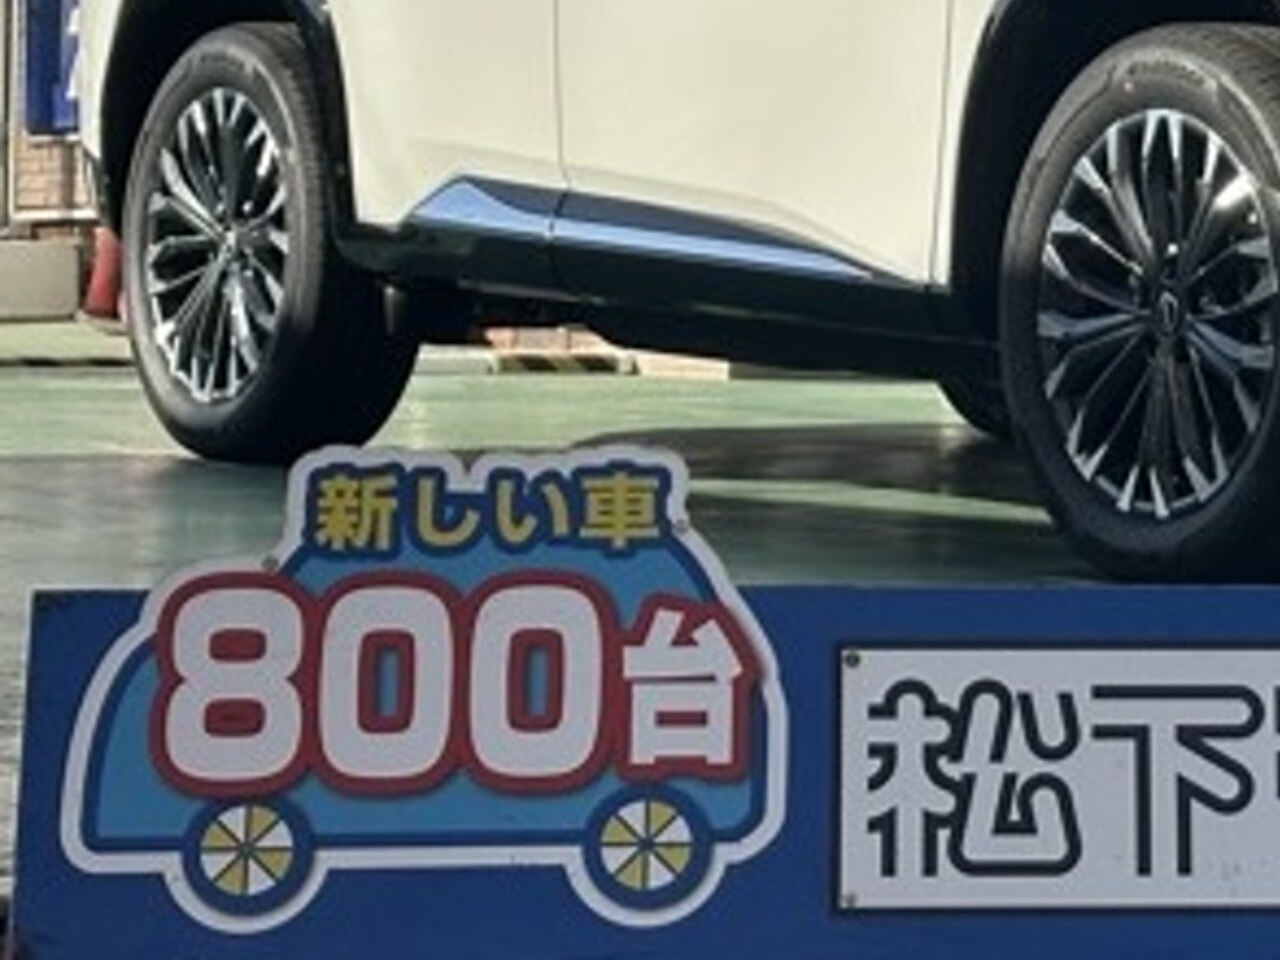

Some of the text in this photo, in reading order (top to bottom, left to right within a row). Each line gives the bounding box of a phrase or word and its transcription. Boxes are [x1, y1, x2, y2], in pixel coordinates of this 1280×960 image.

[314, 474, 662, 549] 新しい車
[165, 584, 744, 782] 800台
